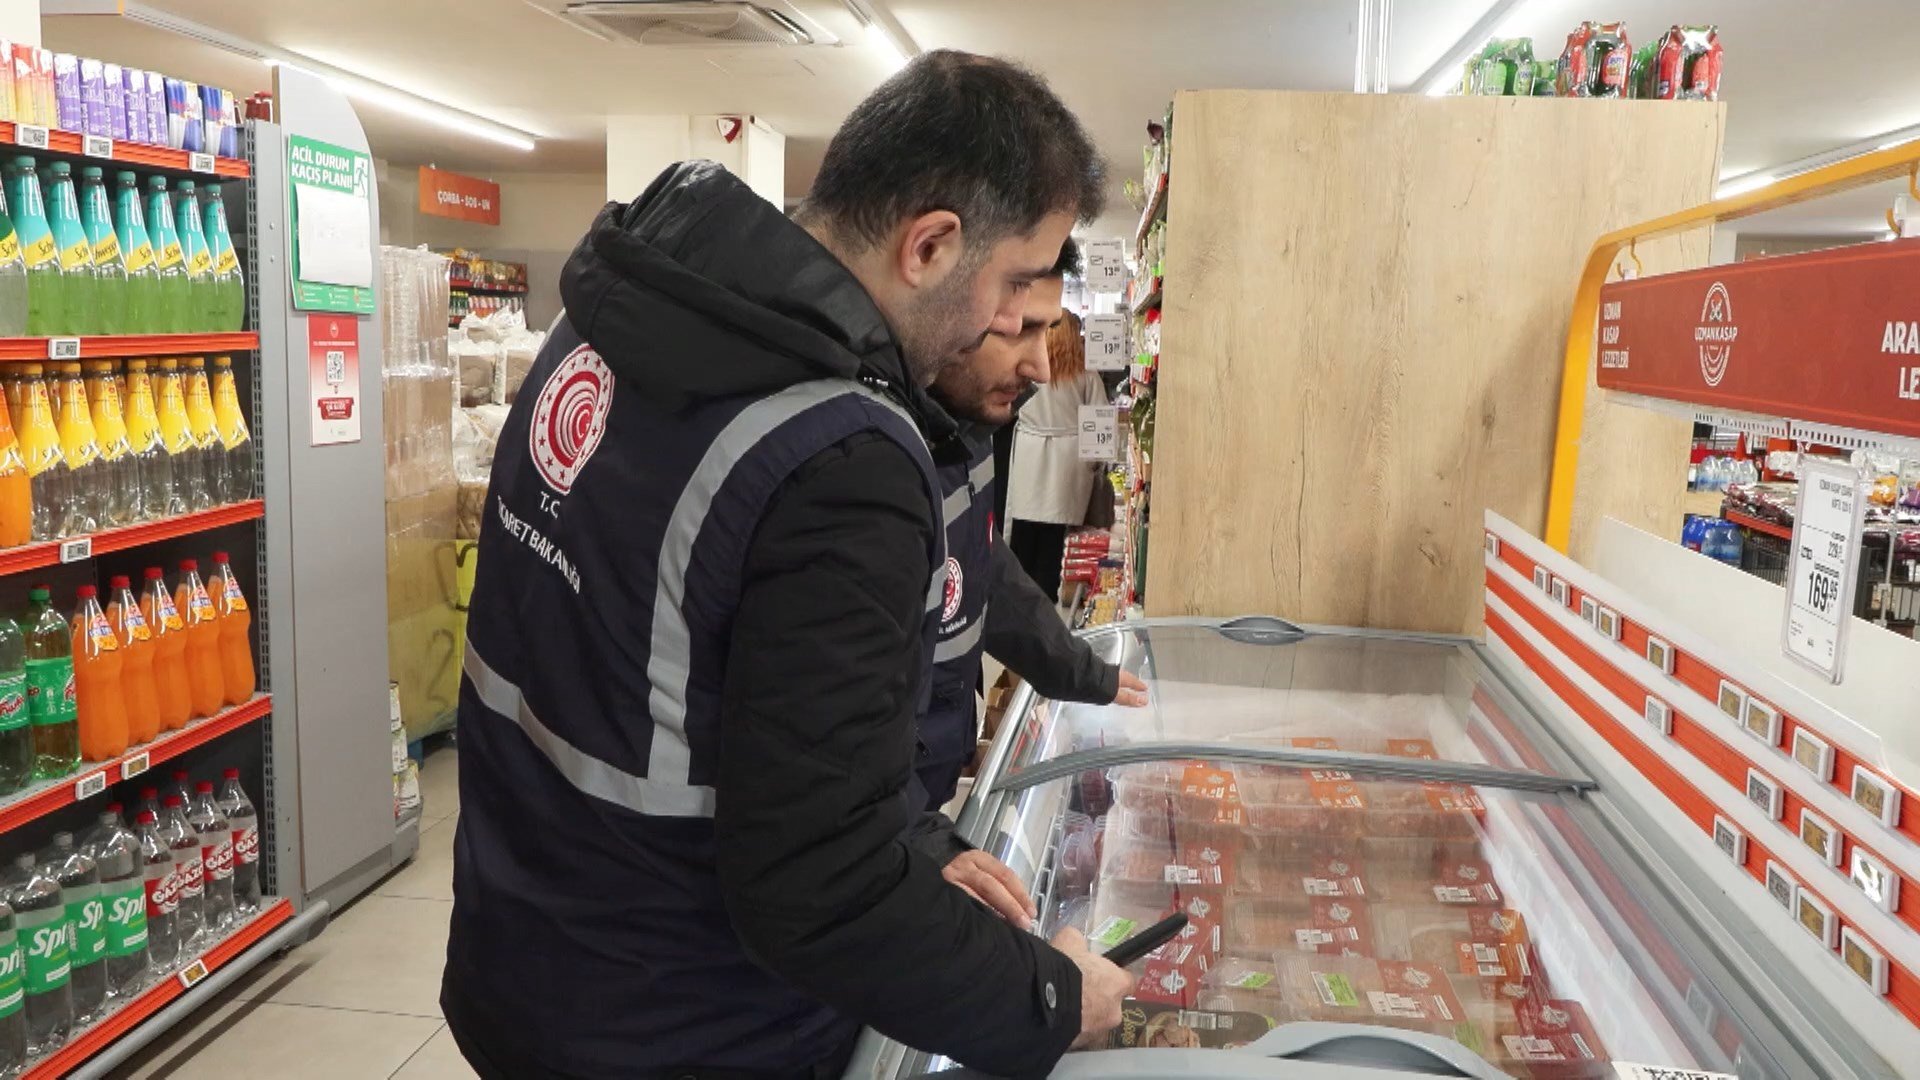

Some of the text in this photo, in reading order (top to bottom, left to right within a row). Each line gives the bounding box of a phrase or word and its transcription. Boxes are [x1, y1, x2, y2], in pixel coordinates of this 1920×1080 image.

[291, 145, 350, 172] ACİL DURUM
[291, 163, 321, 184] KAÇIŞ
[437, 190, 460, 205] ÇORBA
[1881, 320, 1920, 354] ARA
[1899, 366, 1920, 400] LE
